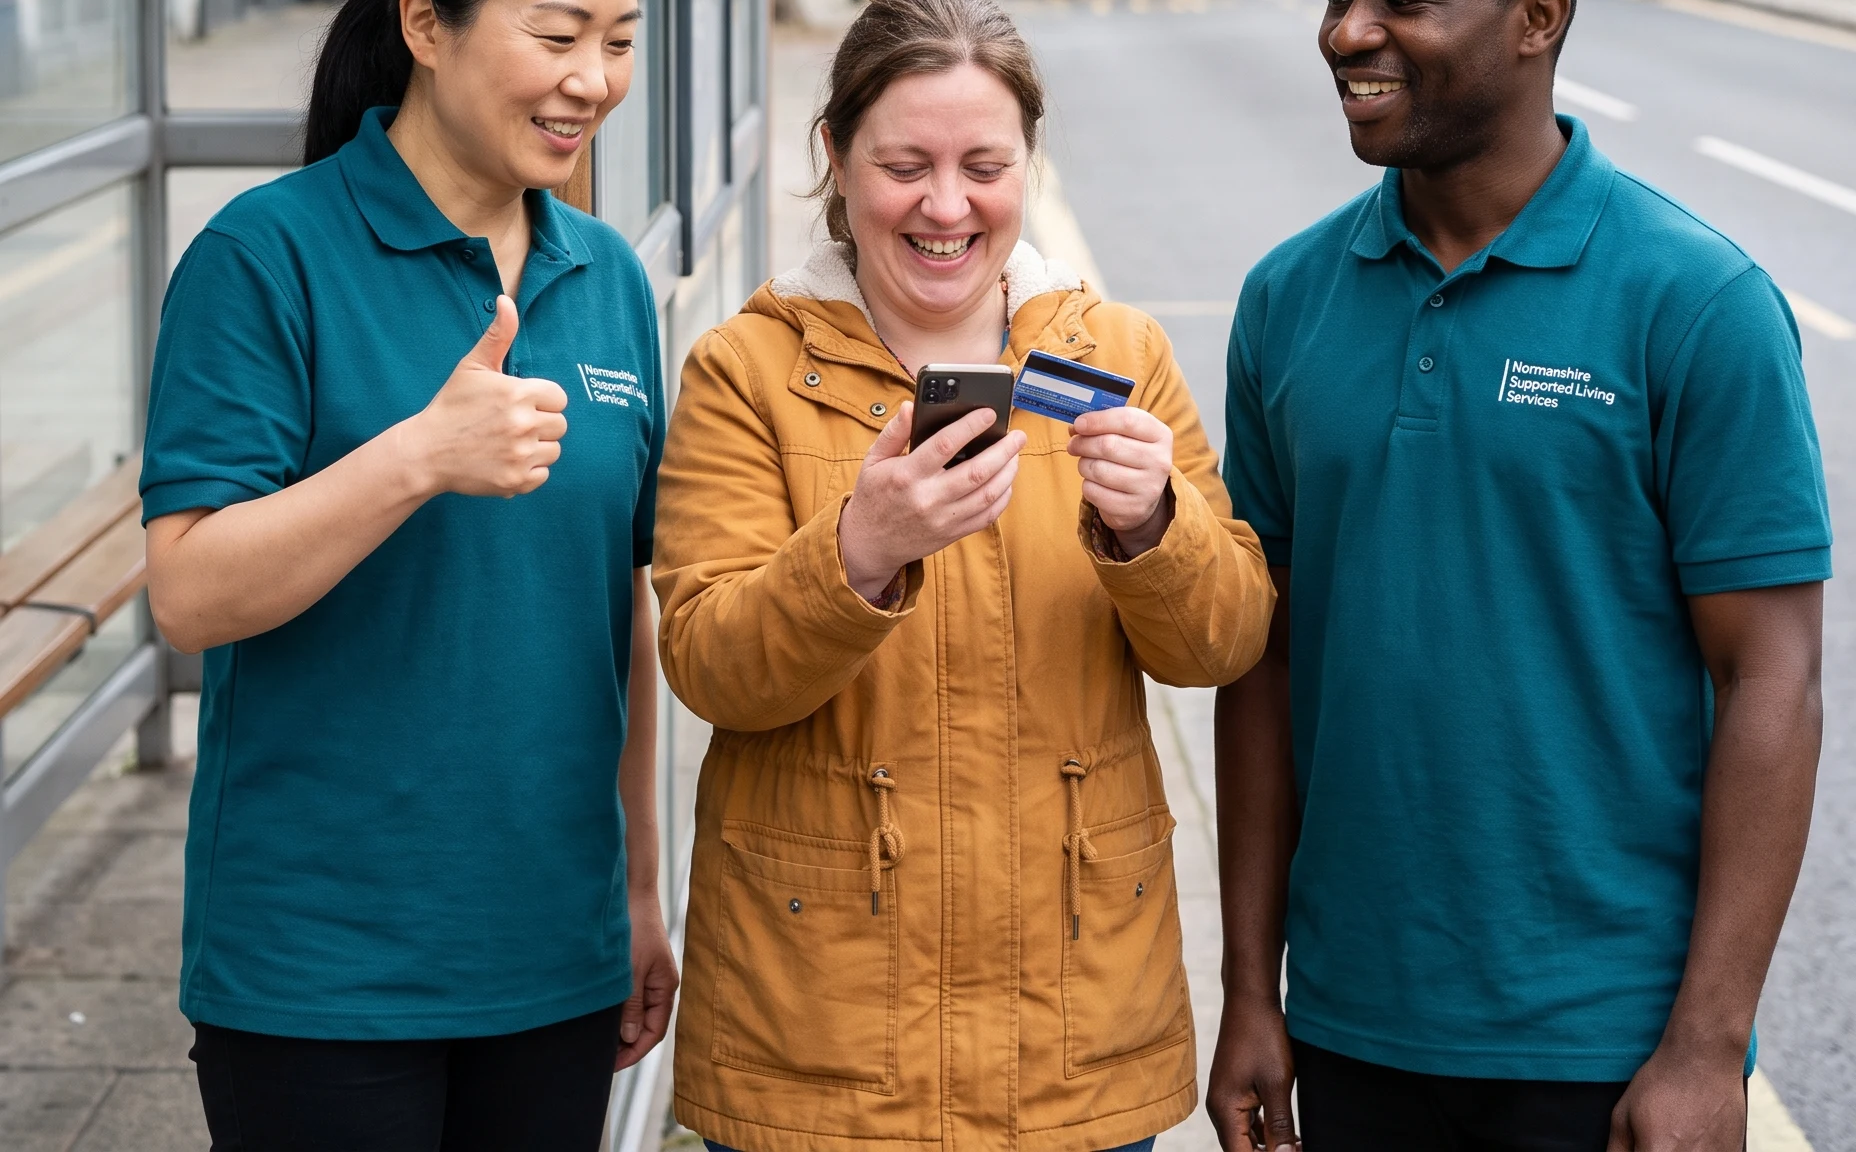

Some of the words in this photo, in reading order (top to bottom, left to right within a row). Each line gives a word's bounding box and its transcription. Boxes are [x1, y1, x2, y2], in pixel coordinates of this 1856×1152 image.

[1512, 360, 1591, 382] Normanshire
[1506, 390, 1559, 408] Services
[1509, 375, 1574, 396] Supported
[1575, 383, 1616, 405] Living
